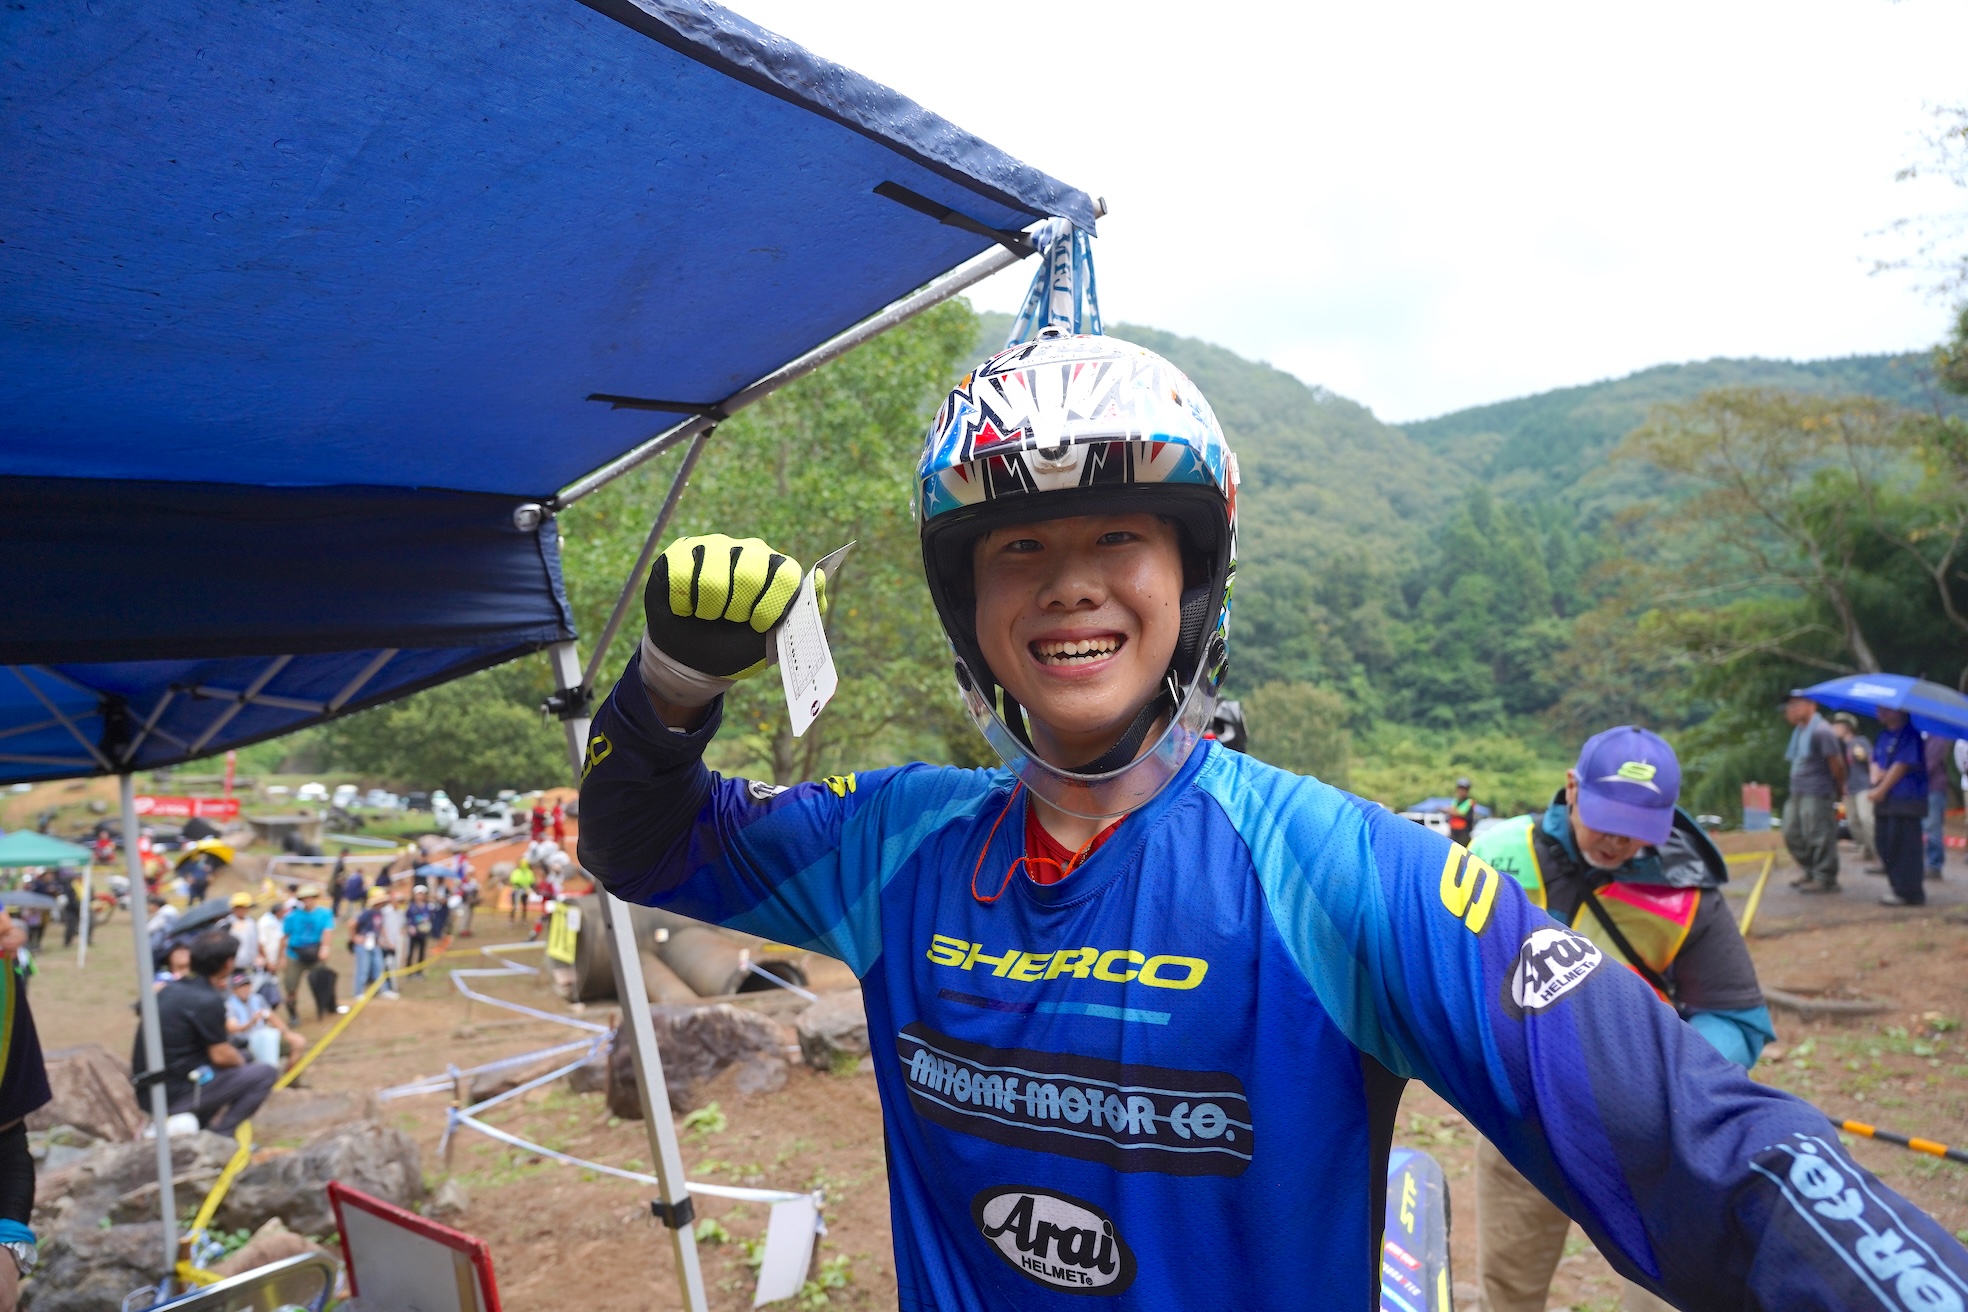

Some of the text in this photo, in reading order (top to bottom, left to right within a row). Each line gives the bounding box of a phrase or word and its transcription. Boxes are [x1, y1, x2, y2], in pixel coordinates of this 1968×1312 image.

[926, 933, 1210, 990] SHERCO
[1025, 1082, 1158, 1136] MOTOR
[1169, 1101, 1236, 1143] CO.
[982, 1196, 1118, 1275] Arai
